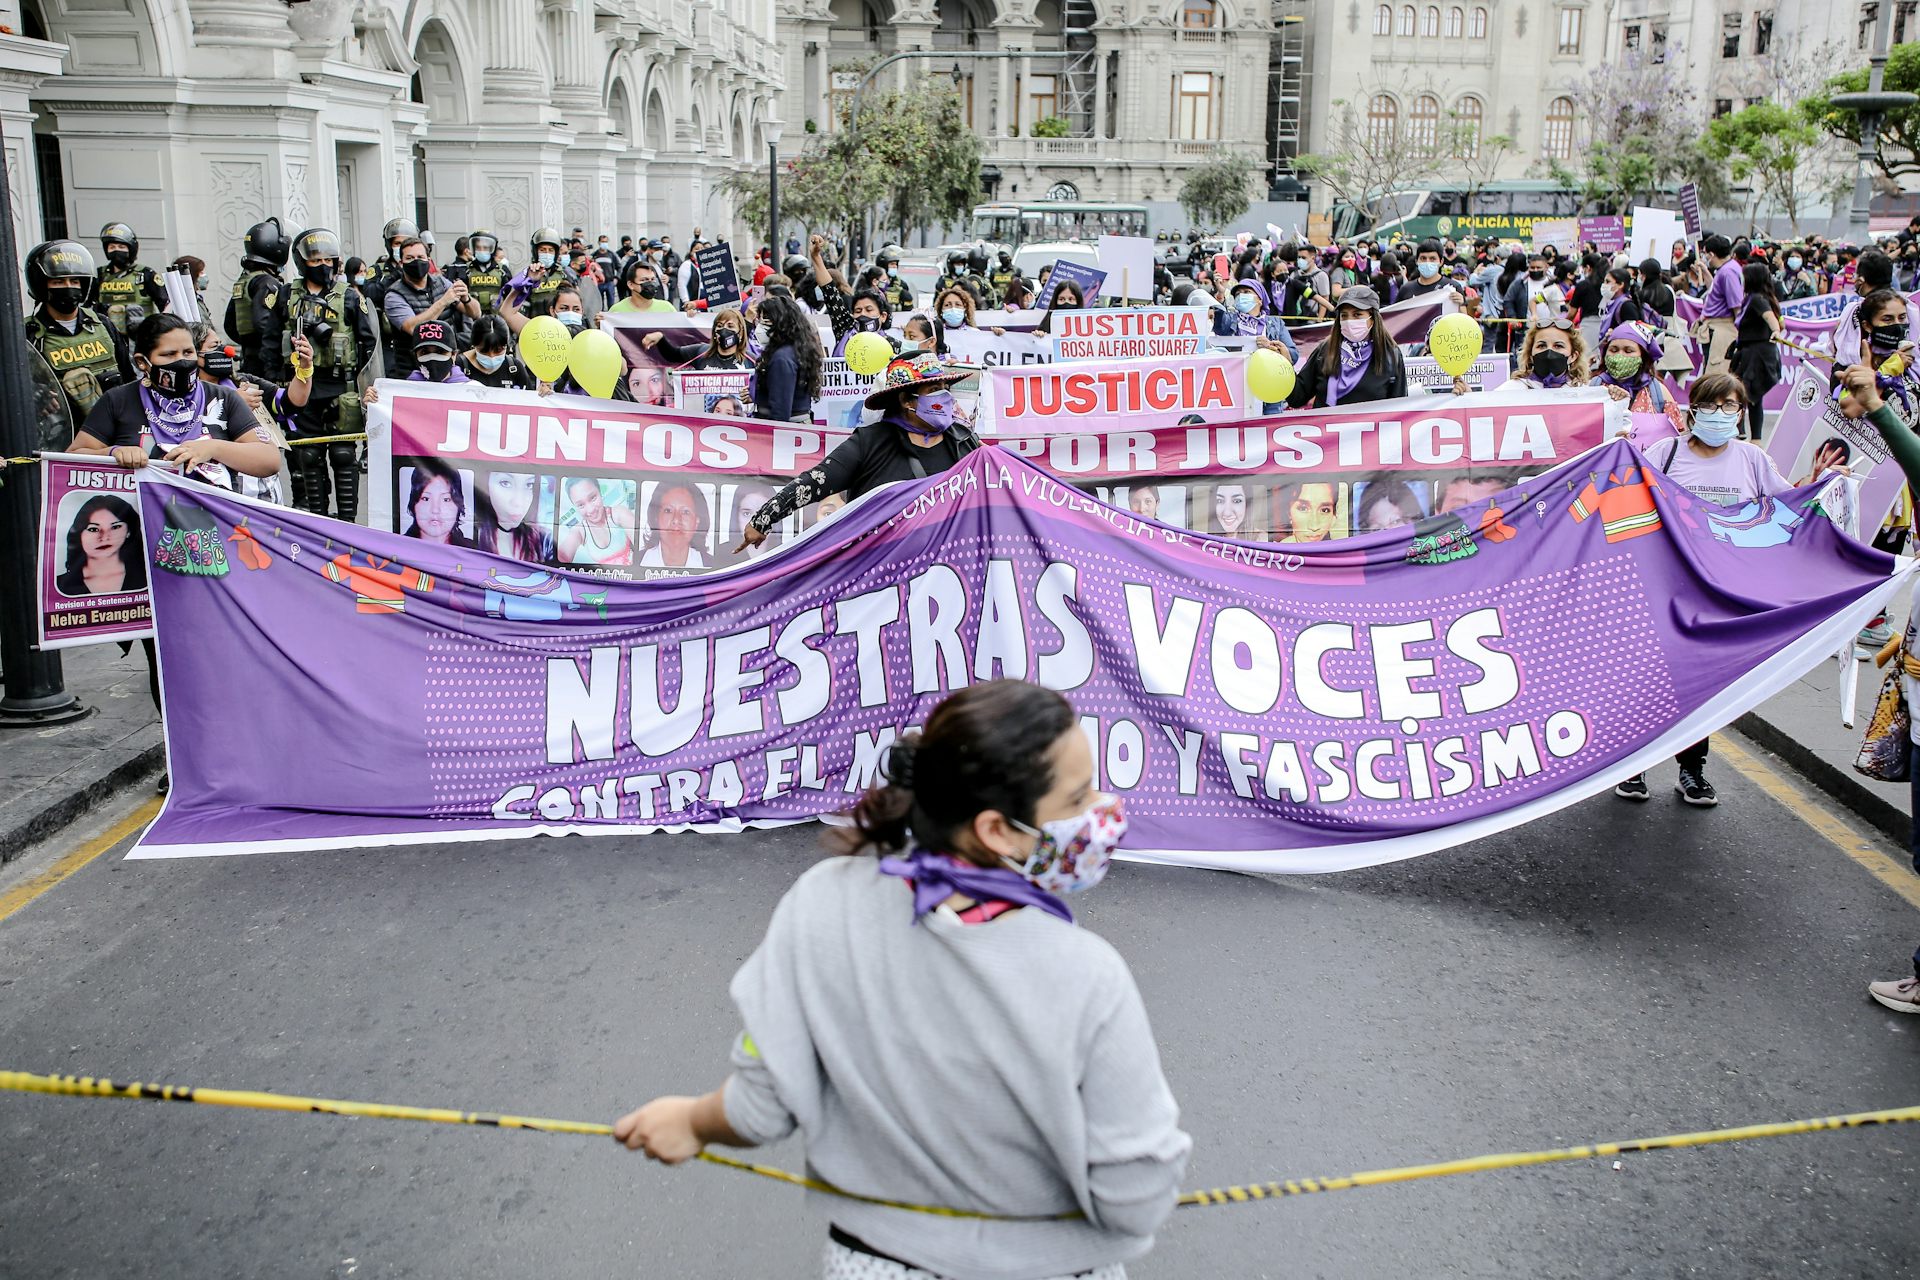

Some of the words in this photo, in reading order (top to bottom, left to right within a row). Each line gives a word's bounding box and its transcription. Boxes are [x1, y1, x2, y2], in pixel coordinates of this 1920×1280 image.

[101, 281, 133, 292] POLICIA
[471, 275, 498, 285] POLICIA
[419, 331, 443, 339] YOU
[1060, 312, 1198, 338] JUSTICIA
[49, 340, 109, 367] POLICIA
[1061, 340, 1094, 358] ROSA
[1098, 339, 1146, 357] ALFARO
[1148, 338, 1199, 356] SUAREZ
[823, 361, 853, 373] JUSTI
[685, 376, 721, 387] JUSTICIA
[723, 376, 746, 387] PARA
[1004, 366, 1234, 418] JUSTICIA
[436, 408, 749, 469] JUNTOS
[999, 431, 1159, 473] POR
[1178, 414, 1557, 471] JUSTICIA
[1823, 410, 1843, 433] BASTA
[1842, 425, 1854, 438] DE
[1851, 430, 1887, 464] IMPUNIDAD
[985, 461, 1014, 490] LA
[86, 598, 97, 607] de
[97, 595, 133, 607] Sentencia
[50, 611, 87, 628] Nelva
[91, 606, 152, 624] Evangelis
[545, 559, 1096, 765] NUESTRAS
[1123, 581, 1521, 722] VOCES
[491, 758, 745, 821] CONTRA
[764, 742, 826, 800] EL
[1160, 723, 1205, 796] Y
